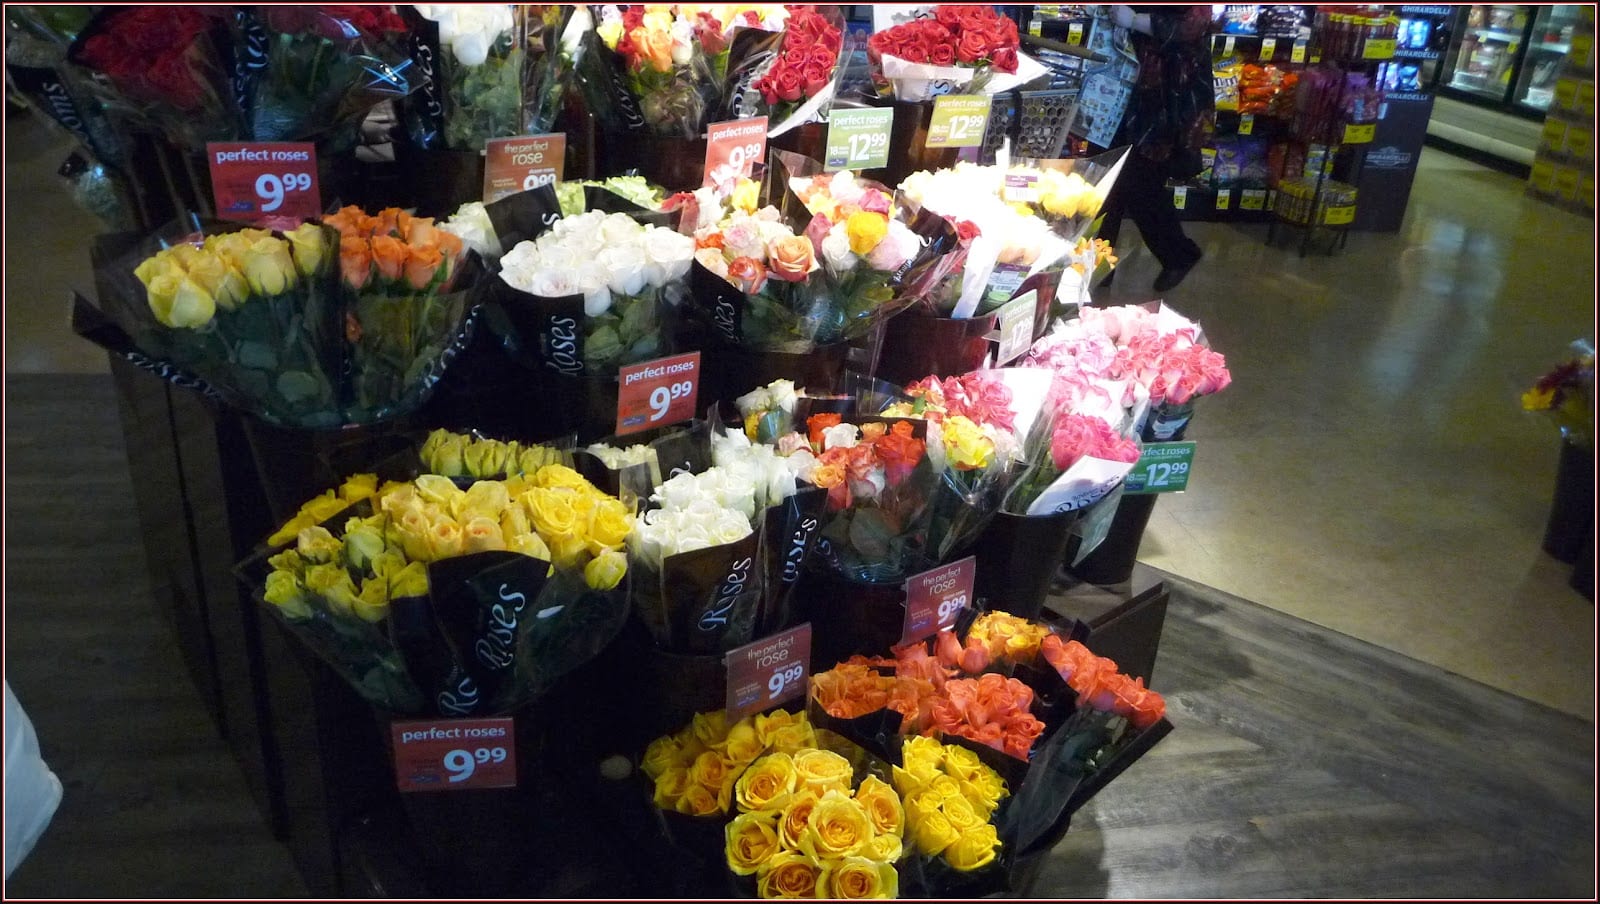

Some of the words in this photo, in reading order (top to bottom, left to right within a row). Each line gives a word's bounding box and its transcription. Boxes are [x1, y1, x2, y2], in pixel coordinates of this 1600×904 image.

[1401, 6, 1451, 15] GHIRARDELLI
[834, 115, 865, 128] perfect
[866, 115, 889, 124] roses
[712, 127, 742, 142] perfect
[742, 125, 764, 135] roses
[215, 148, 268, 164] perfect
[271, 151, 309, 161] roses
[512, 152, 544, 166] rose
[625, 366, 665, 386] perfect
[666, 361, 695, 375] roses
[1166, 446, 1191, 455] roses
[935, 566, 961, 585] perfect
[697, 556, 752, 631] Roses
[929, 578, 956, 596] rose
[747, 649, 762, 661] the
[763, 636, 795, 656] perfect
[756, 648, 789, 670] rose
[402, 727, 462, 744] perfect
[463, 727, 507, 738] roses
